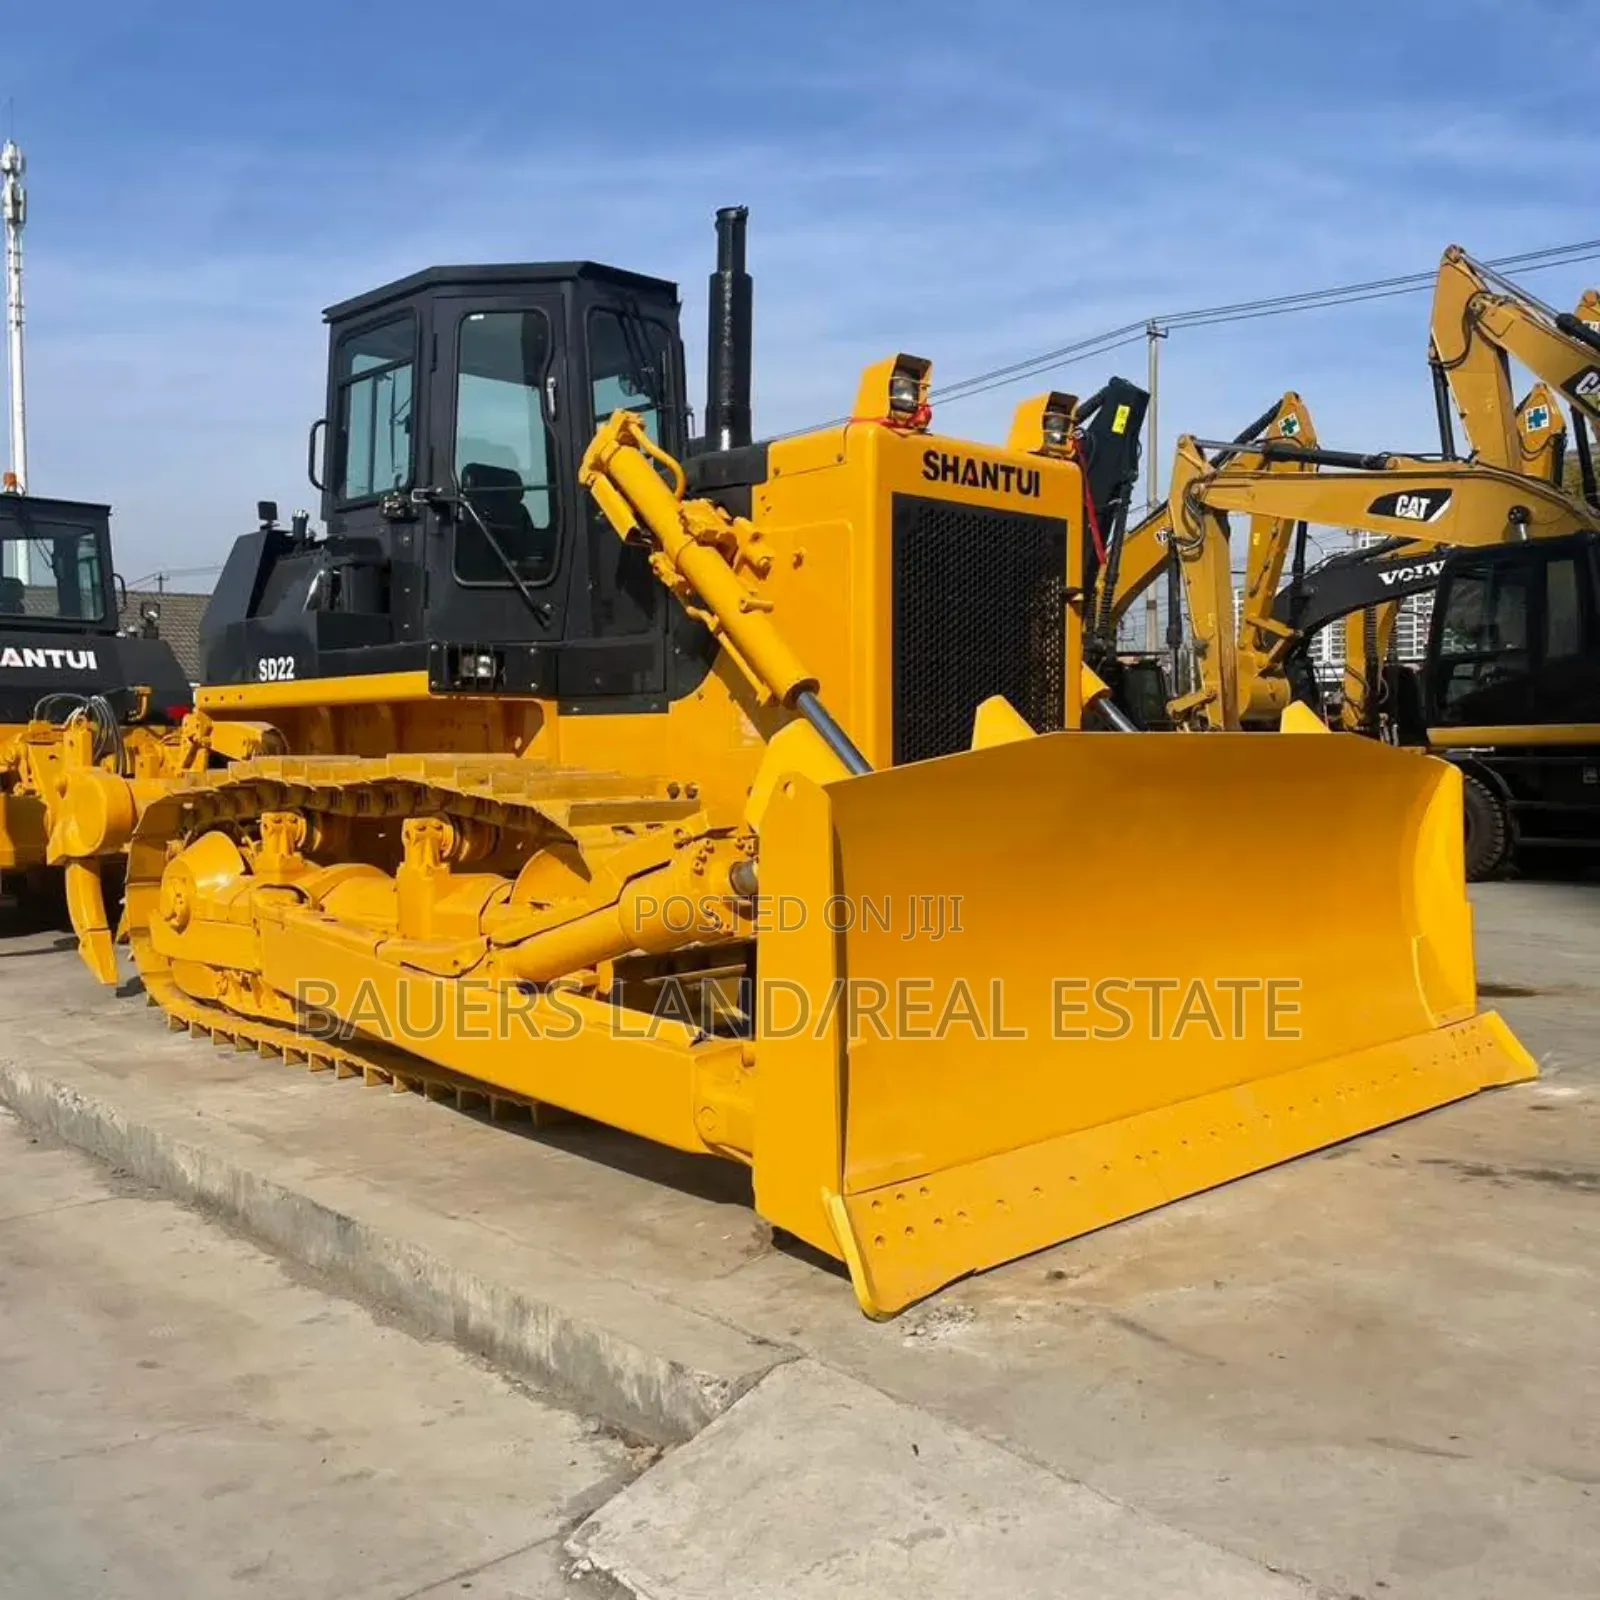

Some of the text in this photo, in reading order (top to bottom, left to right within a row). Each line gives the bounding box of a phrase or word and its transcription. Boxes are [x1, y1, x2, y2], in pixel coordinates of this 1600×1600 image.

[921, 449, 1040, 498] SHANTUI
[1395, 494, 1431, 520] CAT
[0, 647, 97, 670] ANTUI
[258, 656, 295, 682] SD22
